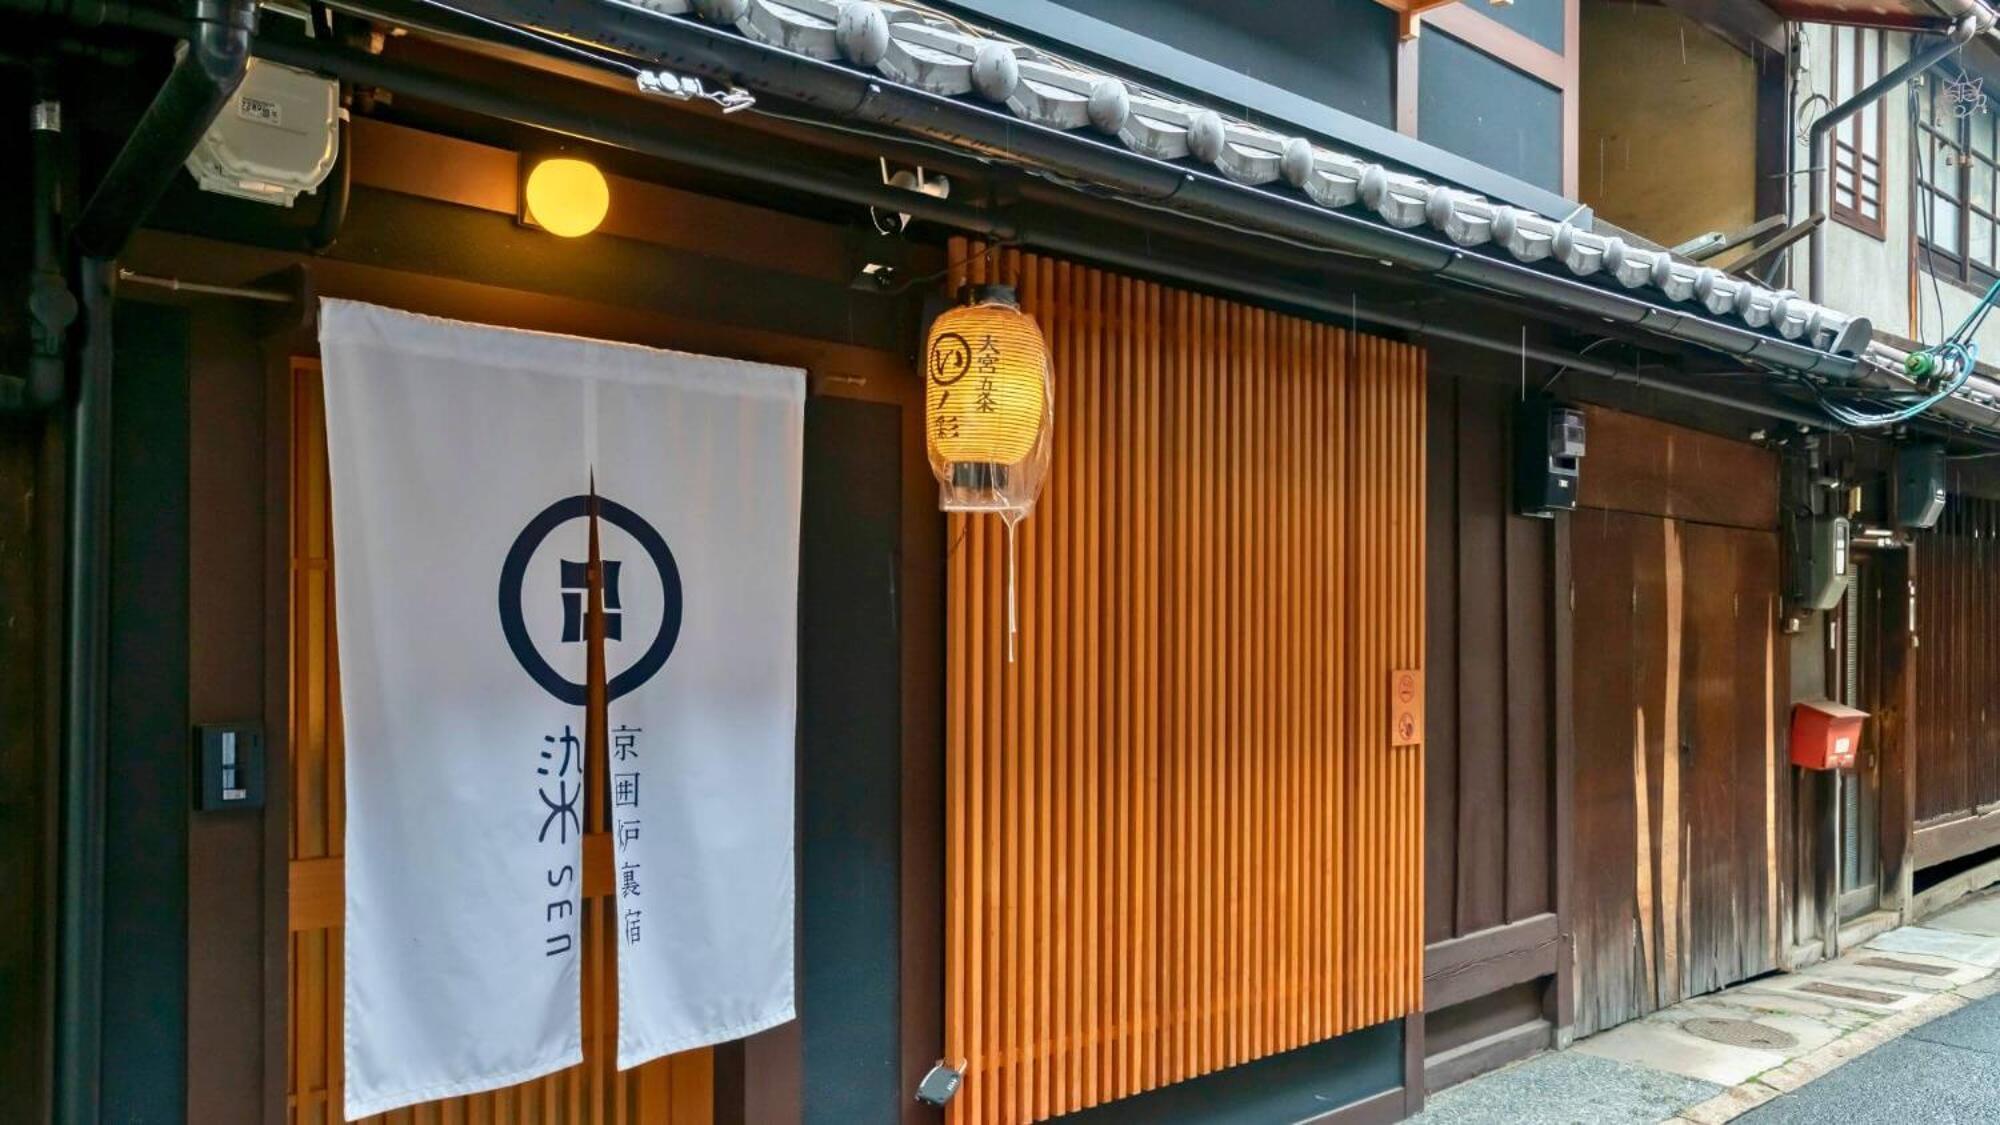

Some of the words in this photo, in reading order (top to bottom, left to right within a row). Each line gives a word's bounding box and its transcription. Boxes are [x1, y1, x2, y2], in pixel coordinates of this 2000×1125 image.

[974, 334, 1000, 413] 大宮五条
[611, 725, 642, 947] 京囲炉裏宿
